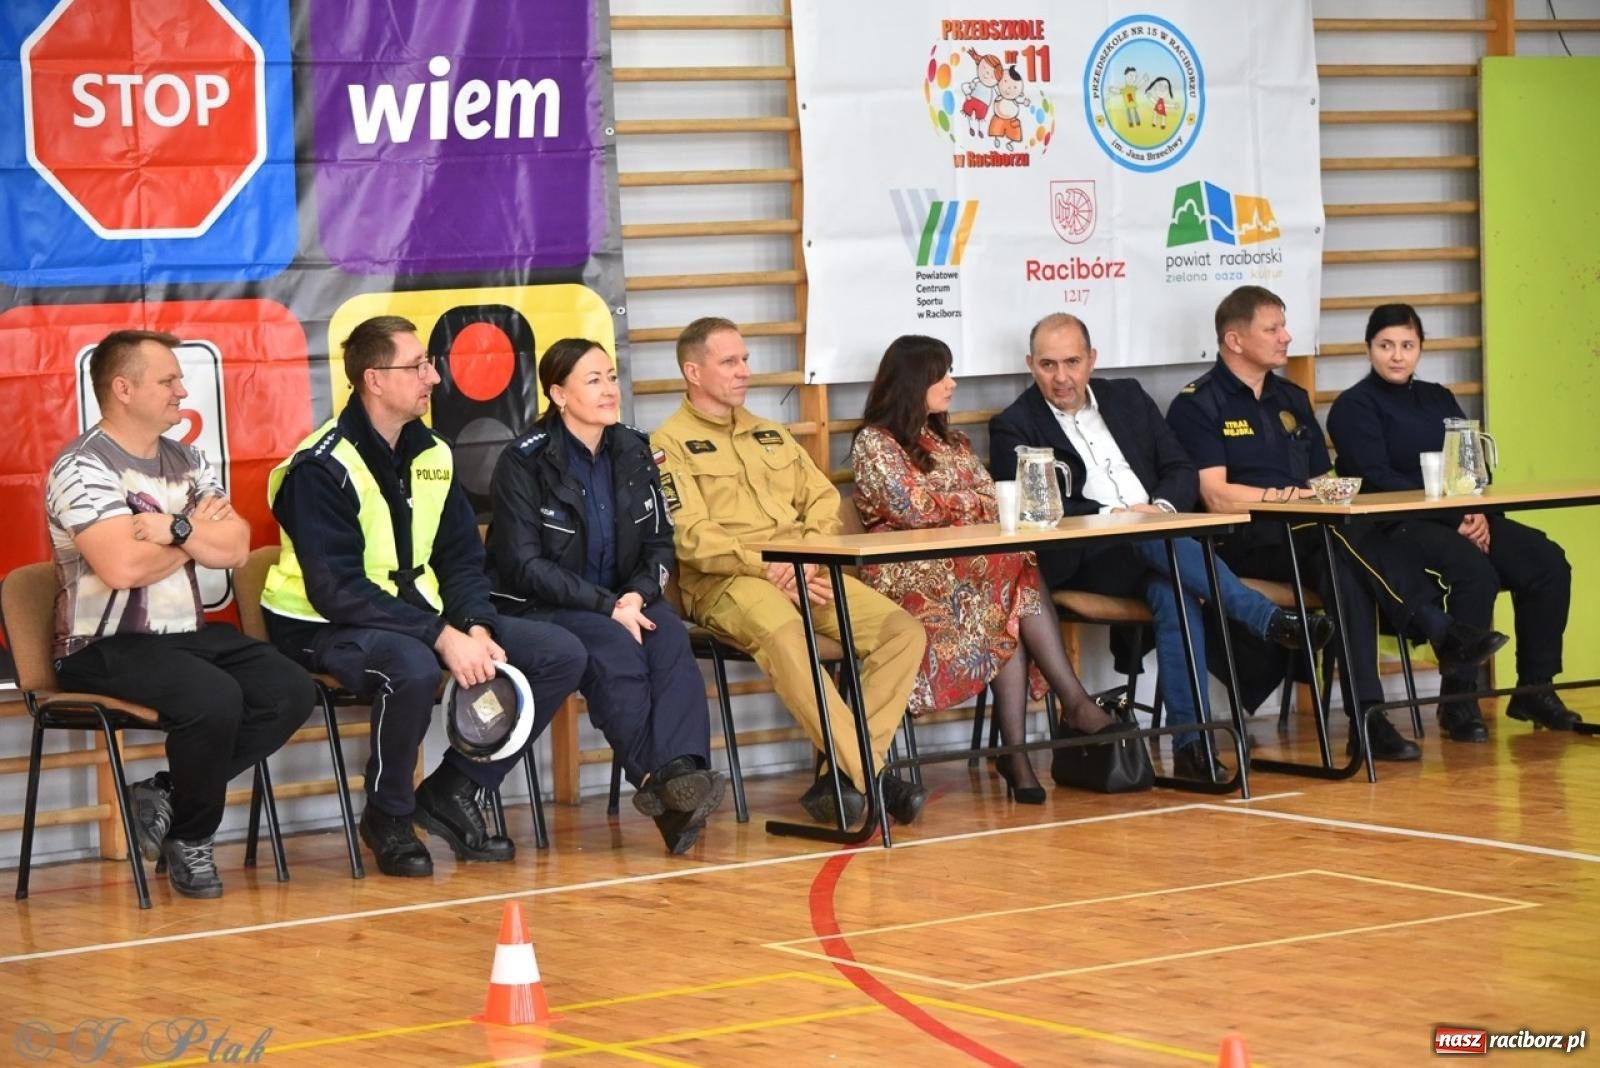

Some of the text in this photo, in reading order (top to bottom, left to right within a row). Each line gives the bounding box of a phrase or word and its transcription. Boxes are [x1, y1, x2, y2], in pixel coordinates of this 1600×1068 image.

[942, 19, 1045, 40] PRZEDSZKOLE
[1004, 44, 1051, 83] nr 11
[1092, 26, 1198, 99] PRZEDSZKOLE NR 15 W RACIBORZU
[71, 72, 231, 128] STOP
[348, 55, 561, 144] wiem
[1126, 149, 1145, 161] Jana
[1146, 135, 1184, 161] Brzechwy
[953, 151, 1031, 168] w Raciborzu
[1025, 255, 1127, 281] Racibórz
[1165, 248, 1283, 272] powiat raciborski
[915, 271, 959, 281] Powiatowe
[1165, 268, 1284, 283] zielona oaza kultur
[915, 284, 951, 294] Centrum
[1063, 288, 1091, 306] 1217
[916, 297, 944, 307] Sportu
[917, 311, 925, 319] w
